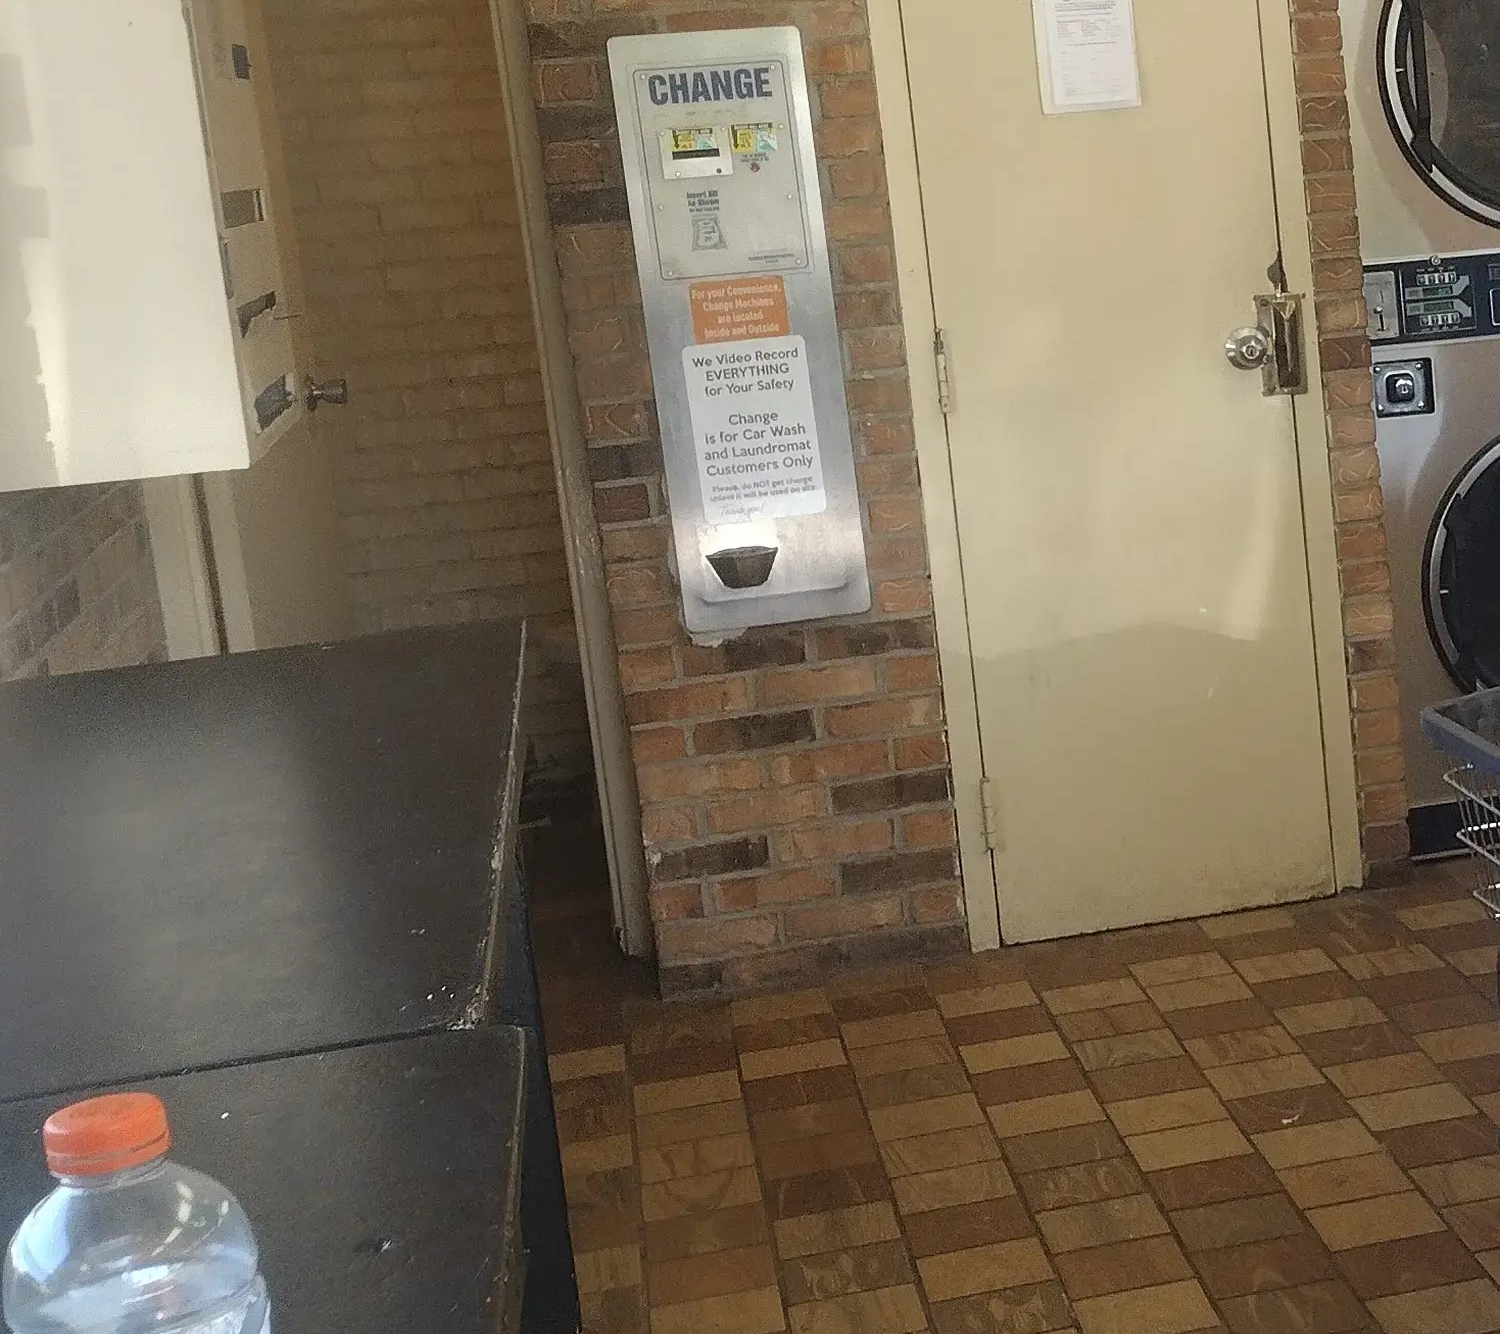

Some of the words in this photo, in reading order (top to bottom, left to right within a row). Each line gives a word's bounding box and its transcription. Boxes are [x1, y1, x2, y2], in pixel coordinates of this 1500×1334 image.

[648, 67, 773, 106] CHANGE
[706, 287, 726, 300] your
[702, 300, 734, 312] Change
[692, 357, 712, 367] We
[716, 353, 751, 365] Video
[755, 347, 798, 361] Record
[706, 362, 789, 381] EVERYTHING
[705, 385, 722, 397] for
[726, 382, 753, 394] Your
[757, 377, 794, 391] Safety
[728, 412, 778, 425] Change
[720, 431, 738, 443] for
[743, 428, 766, 440] Car
[770, 423, 806, 437] Wash
[705, 447, 728, 461] and
[732, 440, 811, 458] Laundromat
[706, 460, 779, 476] Customers
[782, 455, 813, 468] Only
